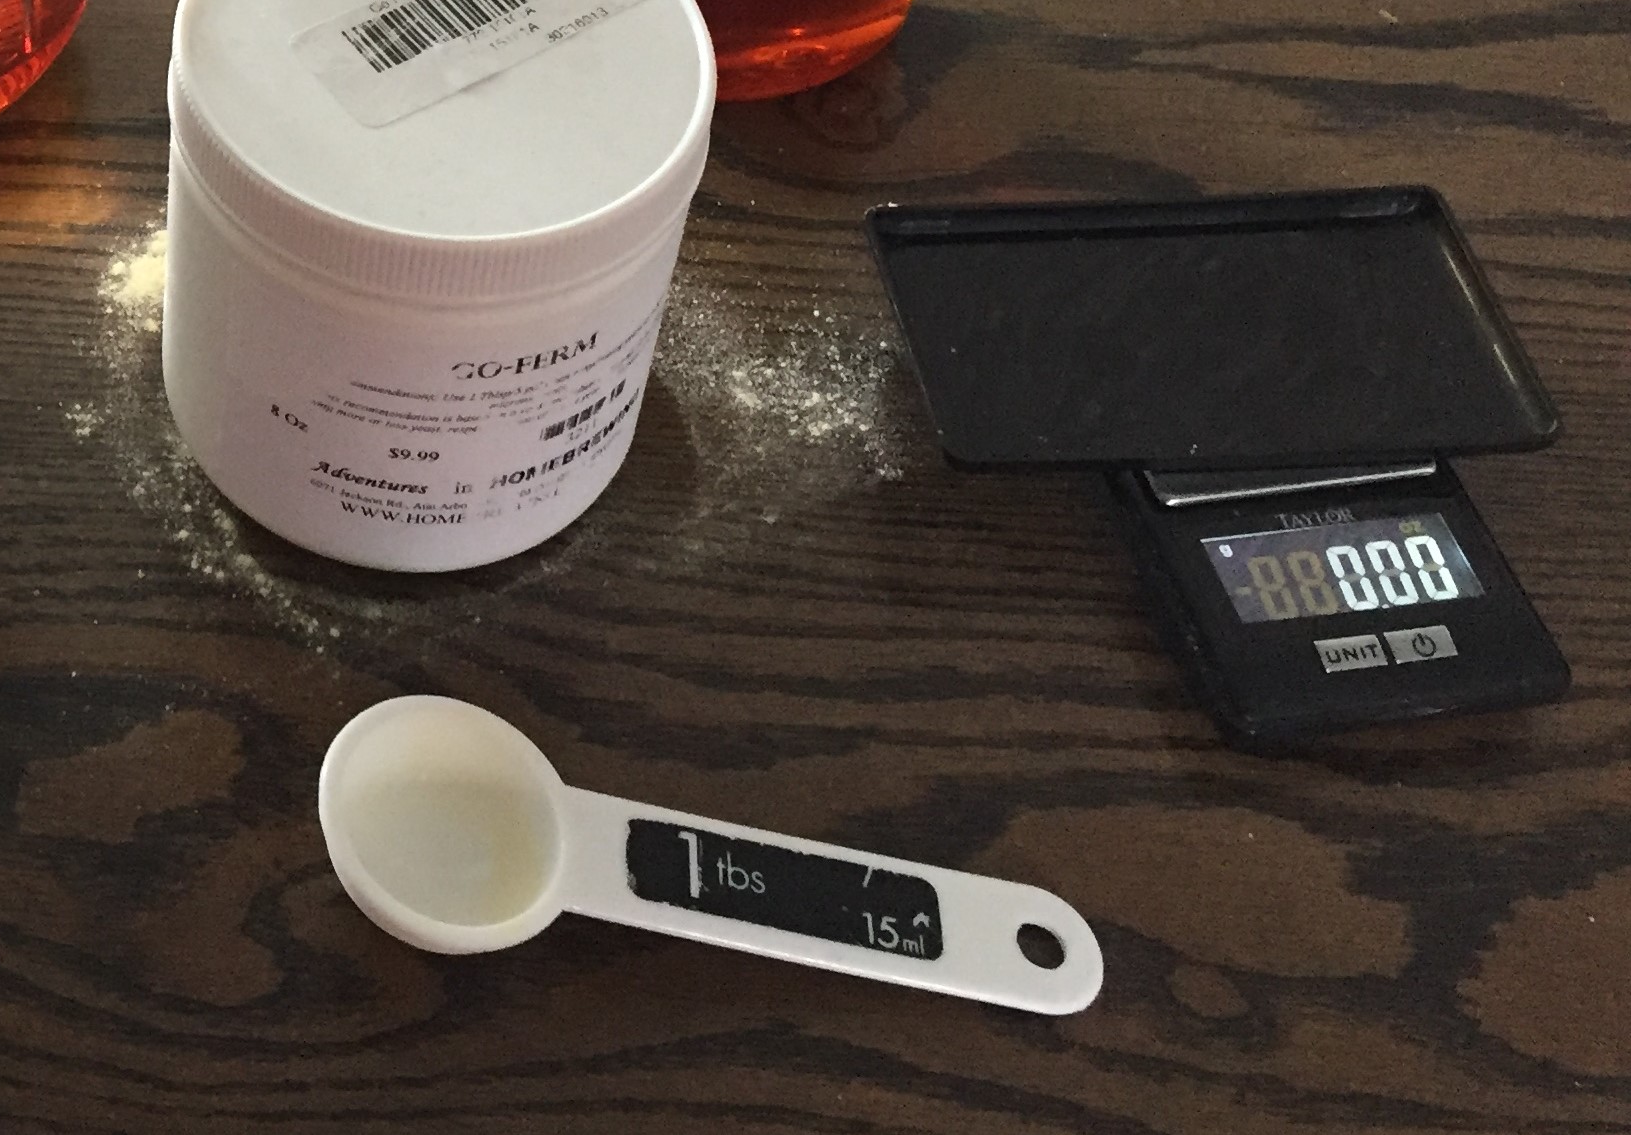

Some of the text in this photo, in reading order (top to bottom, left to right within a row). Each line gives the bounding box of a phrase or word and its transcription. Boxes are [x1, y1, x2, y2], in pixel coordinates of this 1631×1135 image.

[388, 446, 441, 463] $9.99
[310, 460, 429, 496] Adventures
[453, 480, 474, 496] in
[1274, 507, 1358, 530] TAYLOR
[1325, 642, 1379, 665] UNIT
[678, 830, 767, 899] 1 tbs
